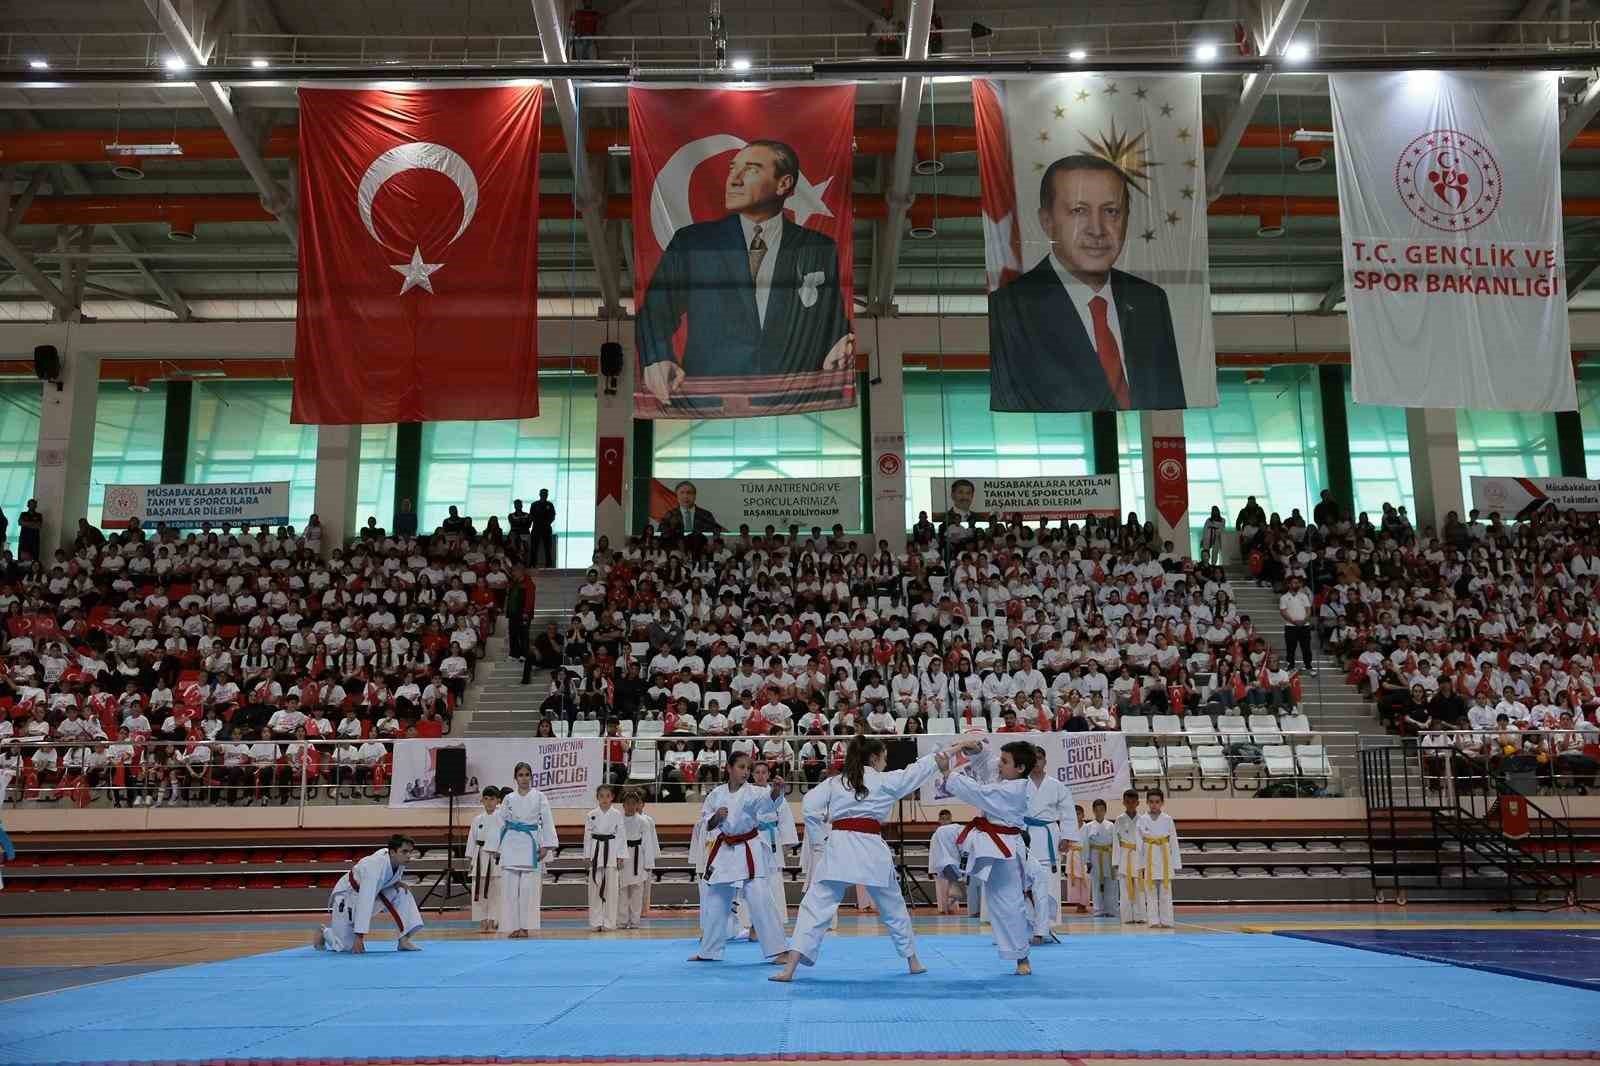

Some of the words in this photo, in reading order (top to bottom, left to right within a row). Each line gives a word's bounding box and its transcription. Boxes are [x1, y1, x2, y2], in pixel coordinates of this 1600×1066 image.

[1352, 242, 1396, 264] T.C.
[1405, 244, 1516, 270] GENÇLİK
[1525, 249, 1557, 268] VE
[1354, 271, 1418, 293] SPOR
[1426, 273, 1558, 297] BAKANLIĞI
[741, 482, 764, 493] TÜM
[828, 482, 841, 492] VE
[1069, 478, 1111, 488] KATILAN
[230, 486, 272, 495] KATILAN
[984, 490, 1016, 498] TAKIM
[1018, 490, 1029, 498] VE
[1032, 488, 1098, 497] SPORCULARA
[147, 498, 176, 506] TAKIM
[178, 498, 191, 506] VE
[193, 497, 259, 506] SPORCULARA
[744, 496, 837, 506] SPORCULARIMIZA
